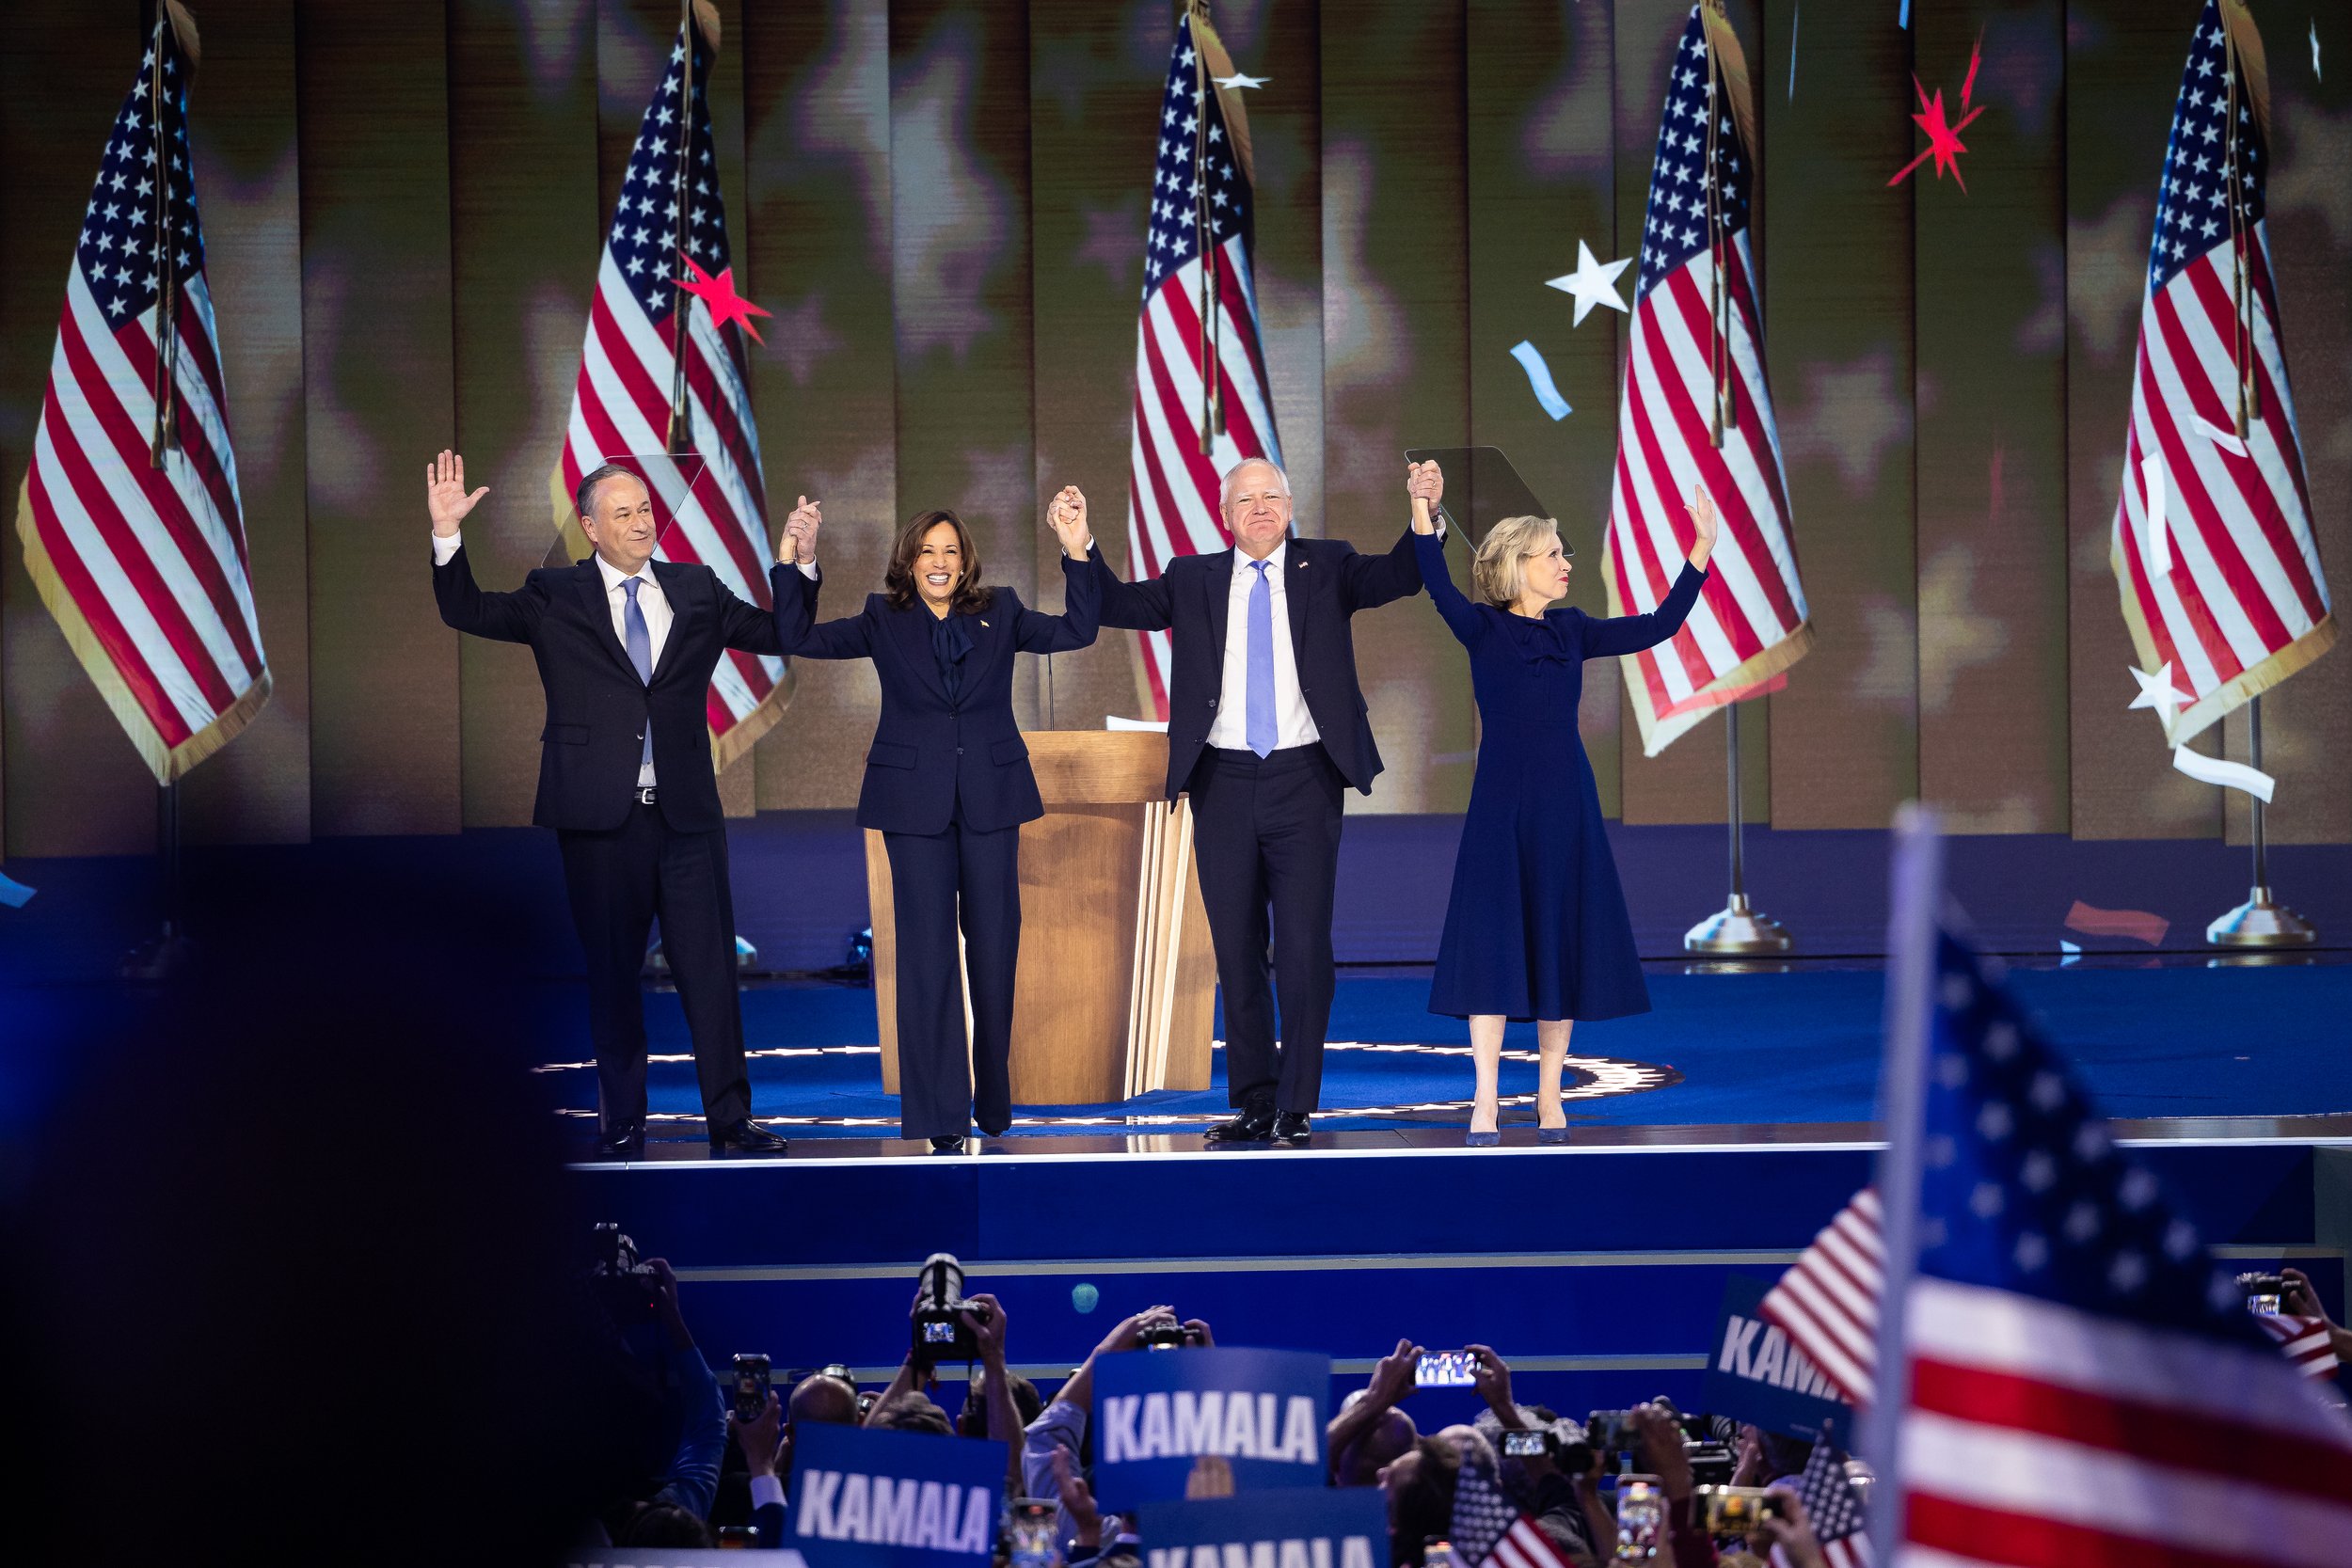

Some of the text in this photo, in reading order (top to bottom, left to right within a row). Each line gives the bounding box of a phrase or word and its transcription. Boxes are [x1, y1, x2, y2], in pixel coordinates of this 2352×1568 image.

[1718, 1315, 1855, 1405] KAM
[1104, 1391, 1318, 1465] KAMALA
[796, 1469, 991, 1555] KAMALA
